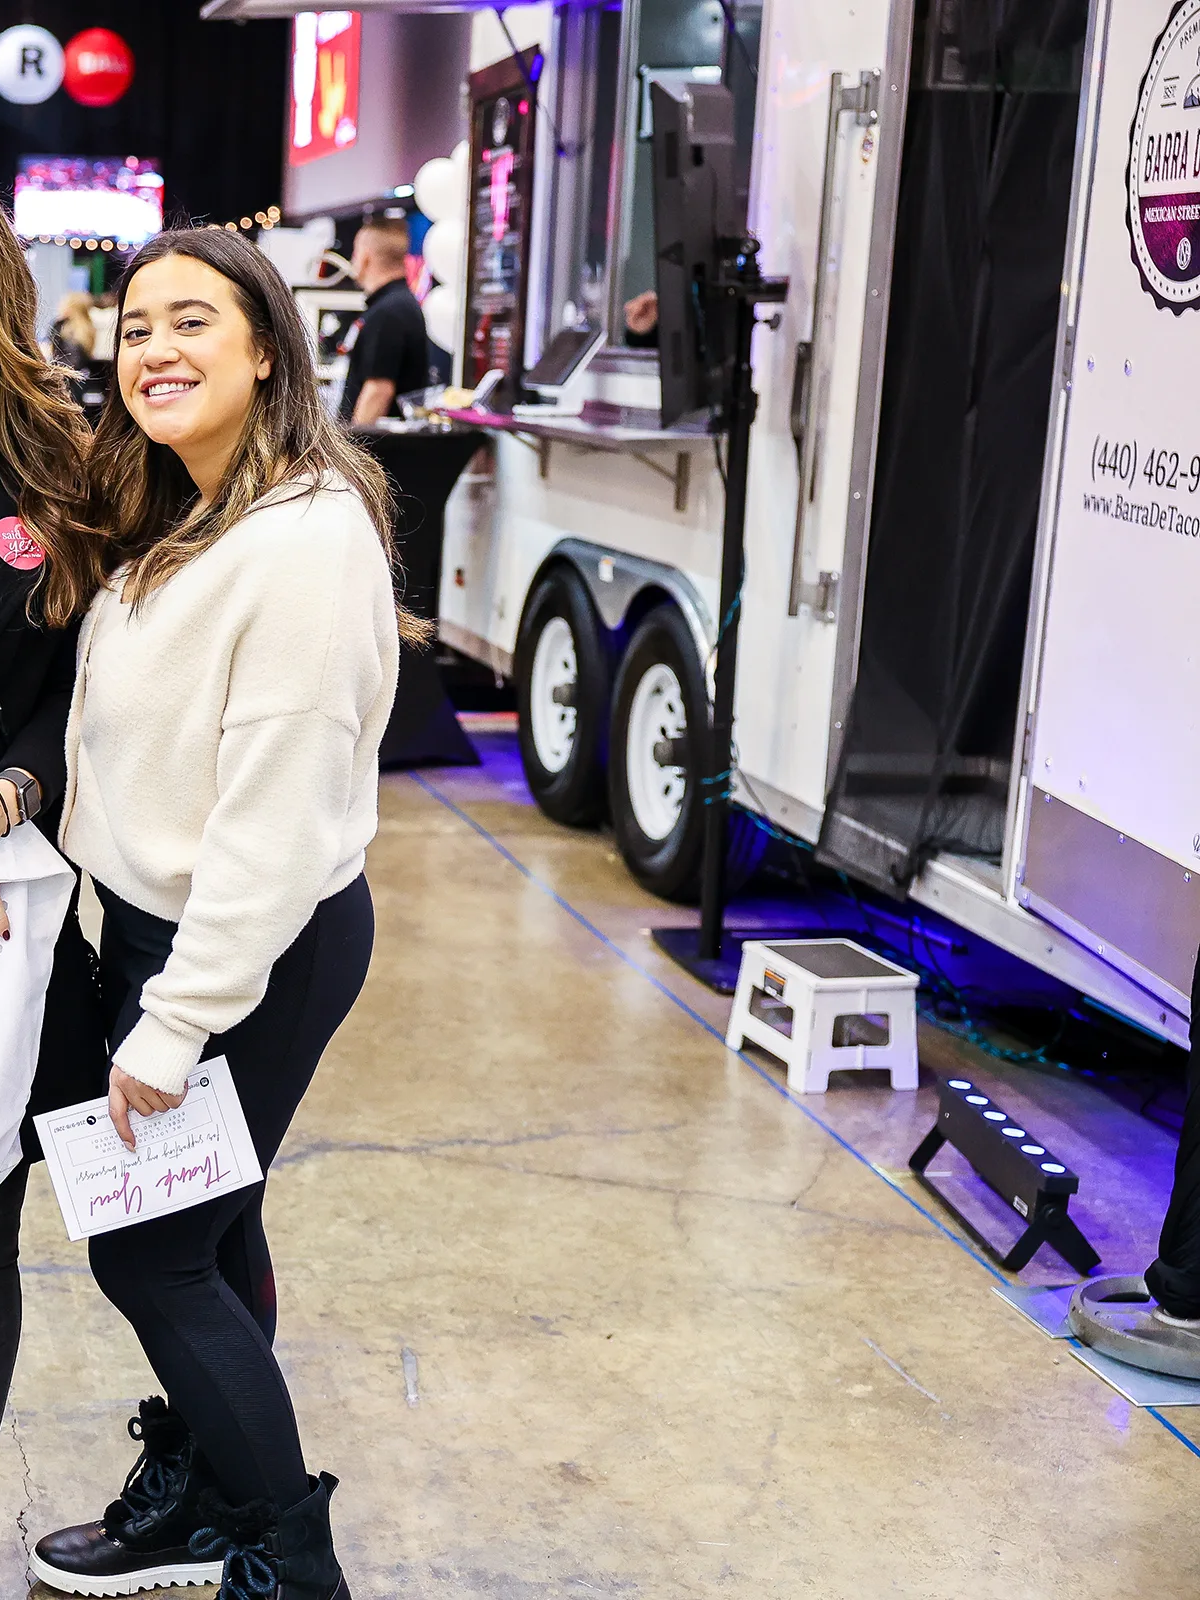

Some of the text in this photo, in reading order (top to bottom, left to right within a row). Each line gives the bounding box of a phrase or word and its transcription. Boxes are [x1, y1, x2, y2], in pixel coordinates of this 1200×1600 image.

[1144, 129, 1189, 182] BARRA
[1144, 206, 1177, 223] MEXICAN
[1091, 433, 1137, 490] (440)
[1083, 493, 1200, 538] www.BarraDeTaco
[162, 1133, 204, 1159] supporting
[90, 1151, 231, 1217] Thank You!
